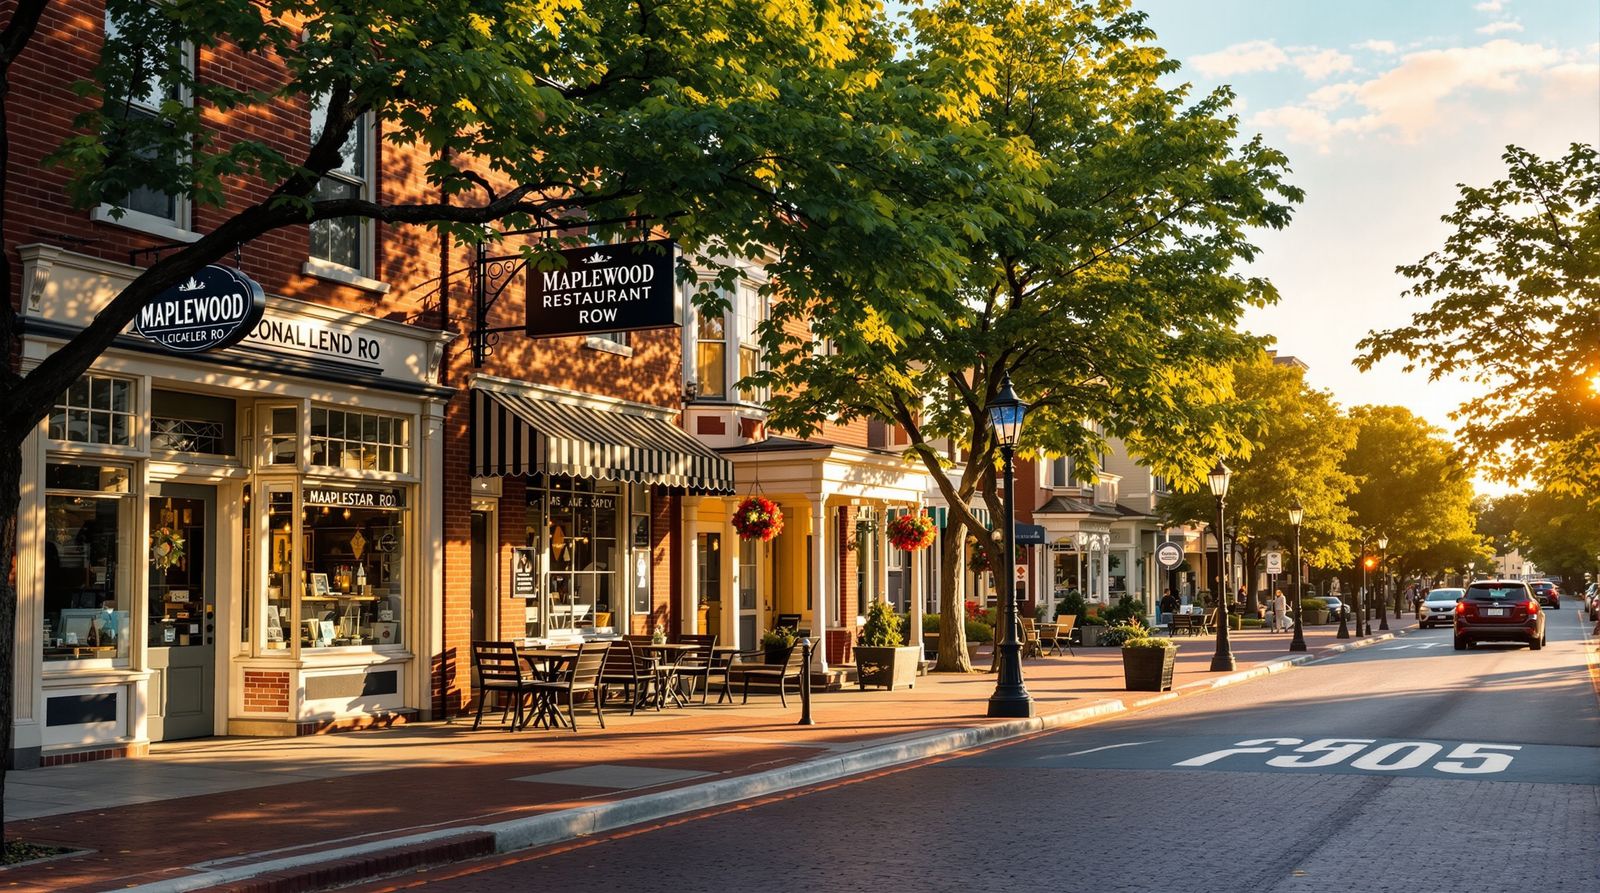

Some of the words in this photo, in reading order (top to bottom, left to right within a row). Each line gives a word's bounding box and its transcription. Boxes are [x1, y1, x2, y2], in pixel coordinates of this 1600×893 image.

[542, 264, 654, 293] MAPLEWOOD
[543, 286, 652, 308] RESTAURANT
[140, 293, 244, 329] MAPLEWOOD
[579, 308, 618, 324] ROW
[211, 328, 224, 340] RO
[358, 337, 380, 360] RO
